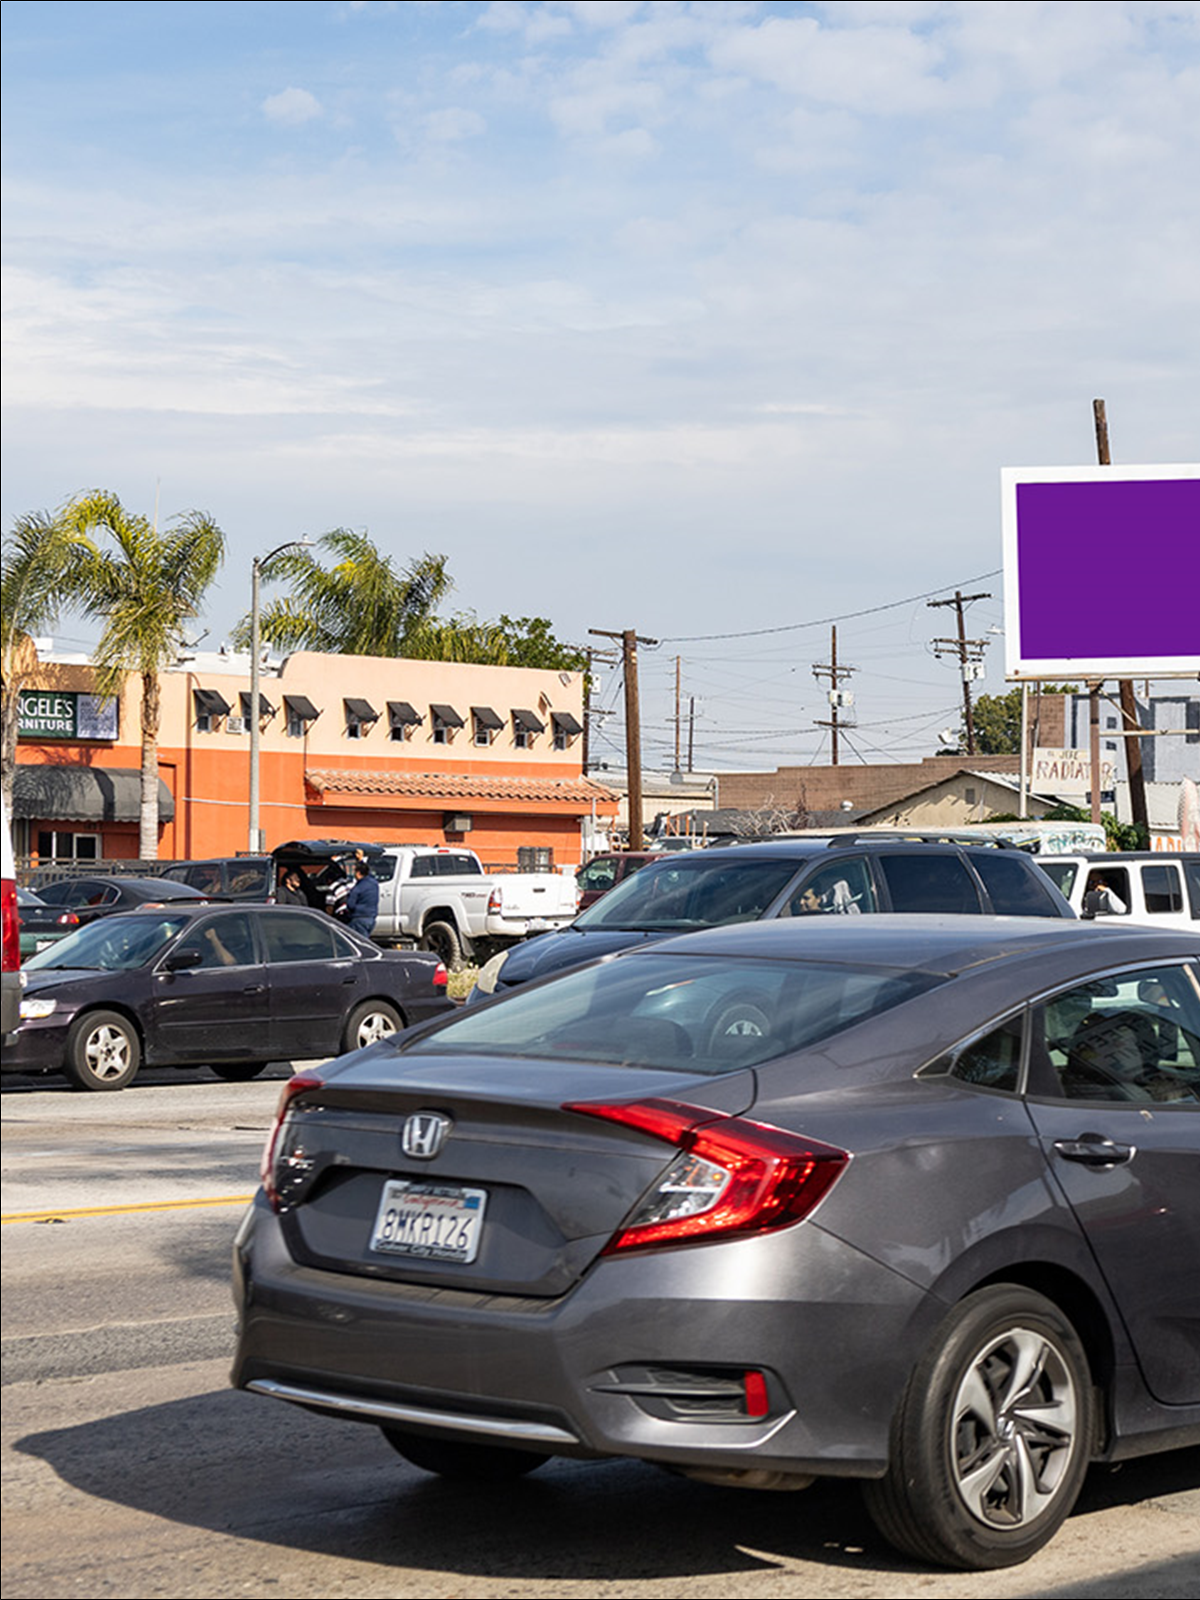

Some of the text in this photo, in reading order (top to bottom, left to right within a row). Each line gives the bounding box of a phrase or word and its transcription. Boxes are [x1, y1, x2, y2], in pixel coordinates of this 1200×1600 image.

[17, 697, 73, 718] NGELE'S
[18, 718, 74, 731] RNITURE
[1036, 760, 1114, 780] RADIATR
